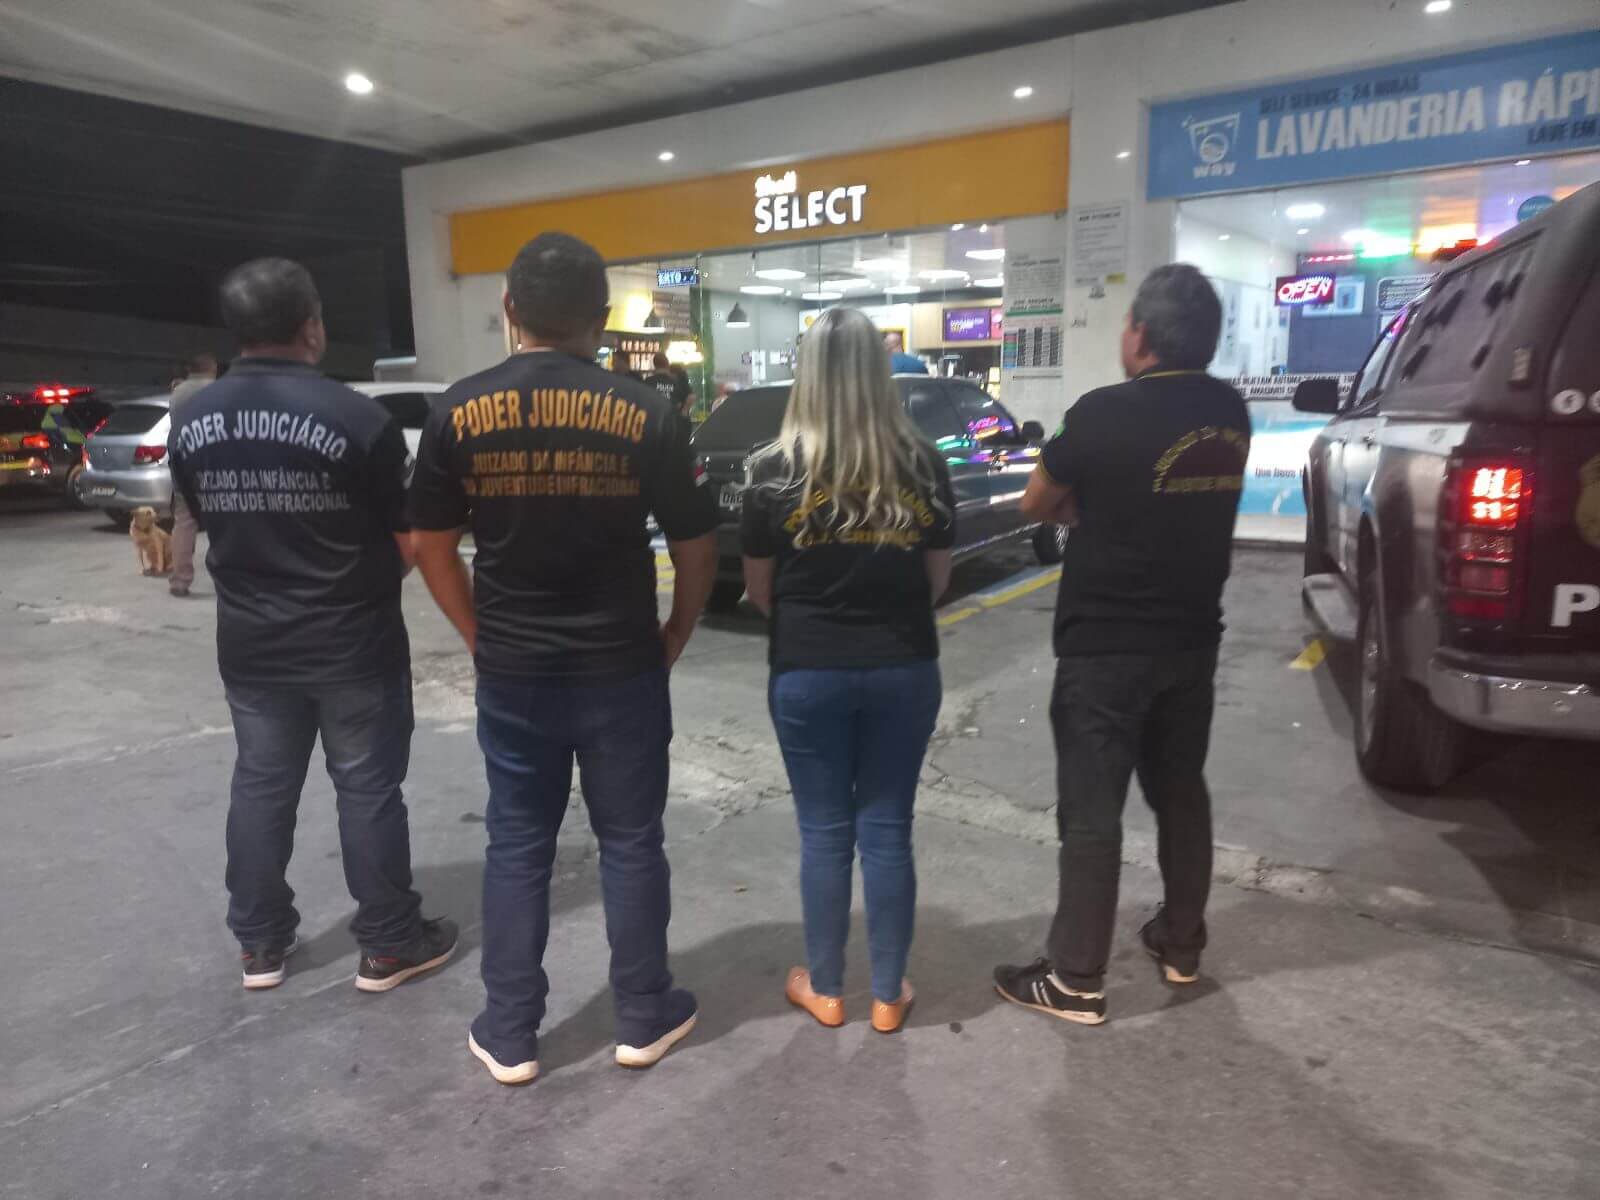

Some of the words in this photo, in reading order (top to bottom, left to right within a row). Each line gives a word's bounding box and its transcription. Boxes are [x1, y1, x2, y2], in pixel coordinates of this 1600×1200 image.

[1256, 84, 1486, 160] LAVANDERIA
[754, 184, 867, 234] SELECT
[1277, 277, 1333, 303] OPEN
[452, 389, 523, 443] PODER
[528, 387, 648, 443] JUDICIÁRIO
[233, 410, 348, 461] JUDICIÁRIO
[241, 470, 259, 489] DA
[473, 452, 528, 474] JUIZADO
[266, 493, 350, 513] INFRACIONAL
